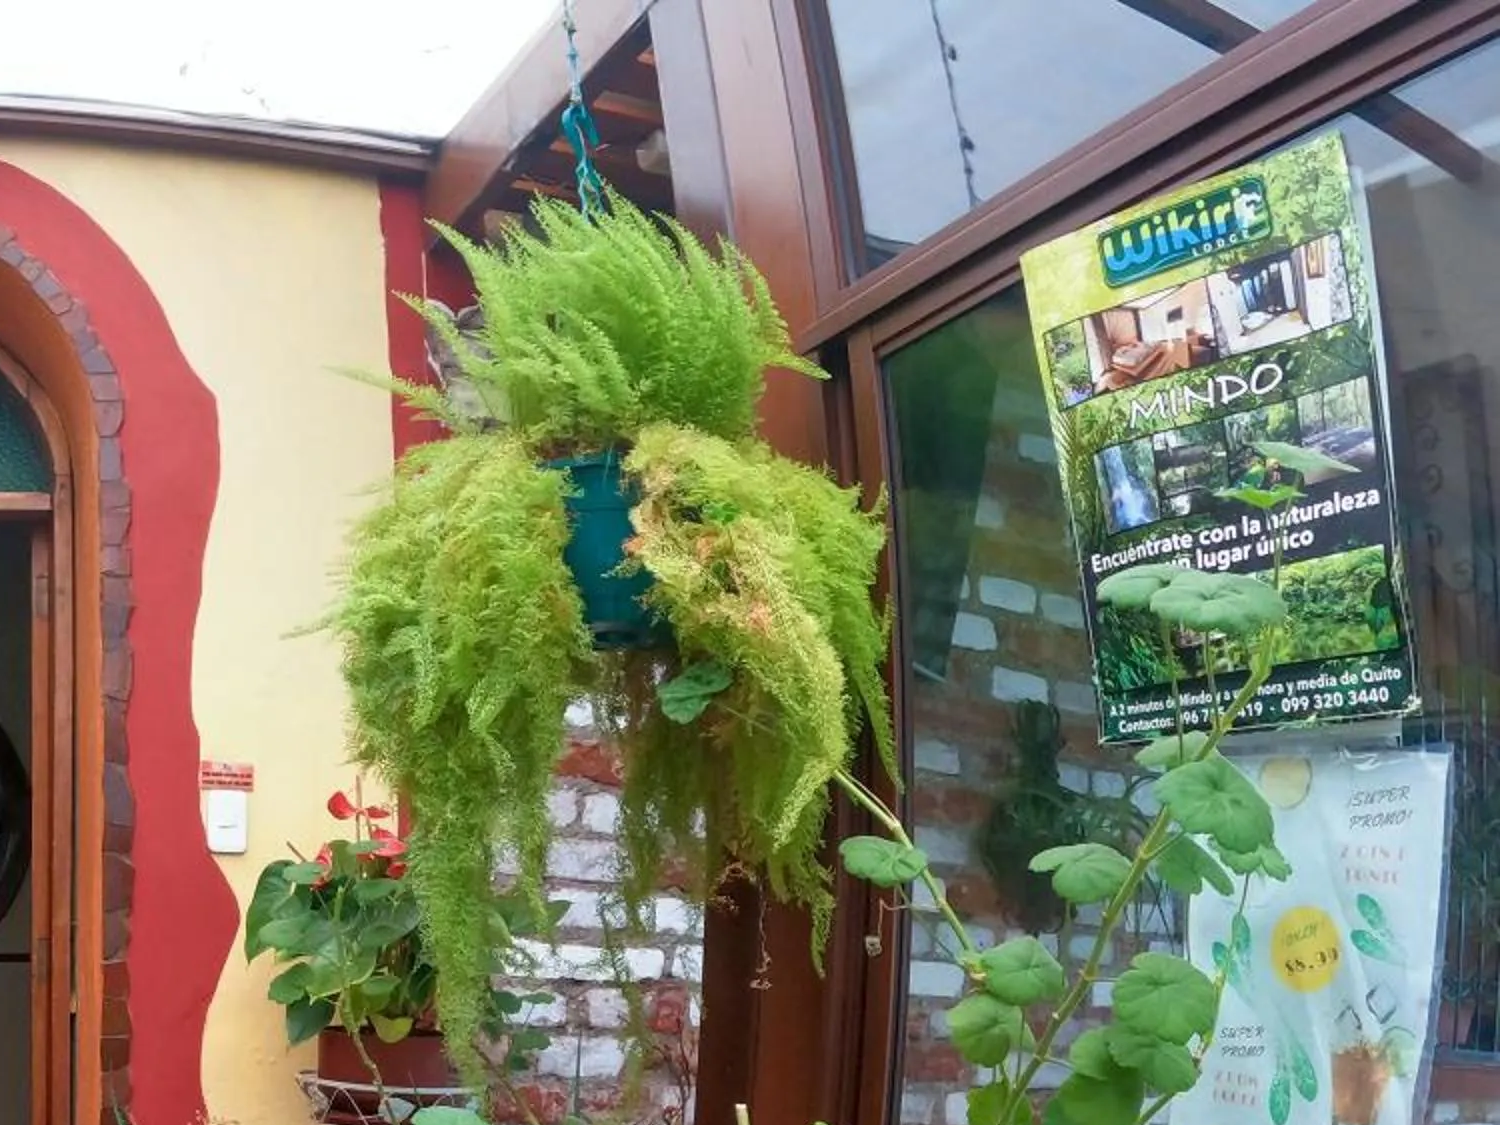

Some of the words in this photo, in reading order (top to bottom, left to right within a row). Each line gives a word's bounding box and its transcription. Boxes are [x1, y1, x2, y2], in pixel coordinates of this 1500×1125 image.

[1192, 229, 1251, 257] LODGE
[1130, 363, 1283, 429] MINDO
[1091, 534, 1193, 573] Encuéntrate
[1199, 524, 1236, 546] con
[1242, 516, 1261, 535] la
[1196, 541, 1252, 571] lugar
[1286, 681, 1294, 697] y
[1297, 673, 1337, 691] media
[1340, 671, 1359, 685] de
[1361, 666, 1402, 683] Quito
[1281, 697, 1309, 713] 099
[1313, 692, 1343, 710] 320
[1348, 686, 1389, 706] 3440
